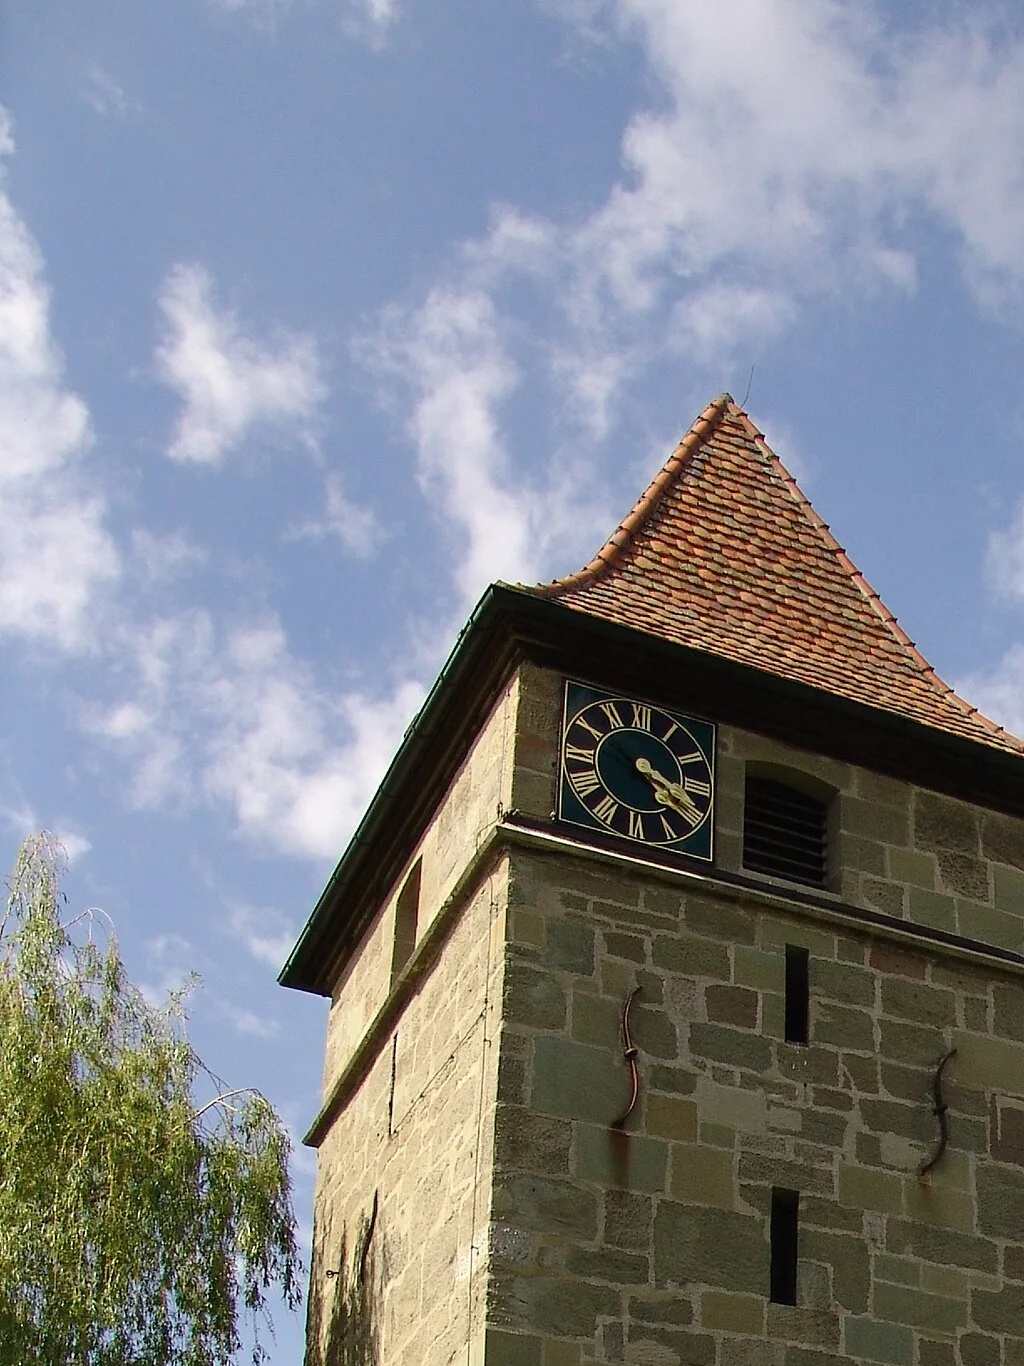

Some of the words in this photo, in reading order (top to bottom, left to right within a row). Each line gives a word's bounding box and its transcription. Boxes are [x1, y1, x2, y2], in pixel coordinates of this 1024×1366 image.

[575, 716, 604, 741] X
[599, 702, 625, 730] XI
[631, 703, 652, 732] XII
[662, 723, 679, 742] I
[566, 743, 594, 764] IX
[678, 752, 703, 765] II
[570, 770, 600, 799] VIII
[684, 776, 710, 798] III
[592, 795, 619, 825] VII
[628, 811, 645, 840] VI
[659, 813, 678, 839] V
